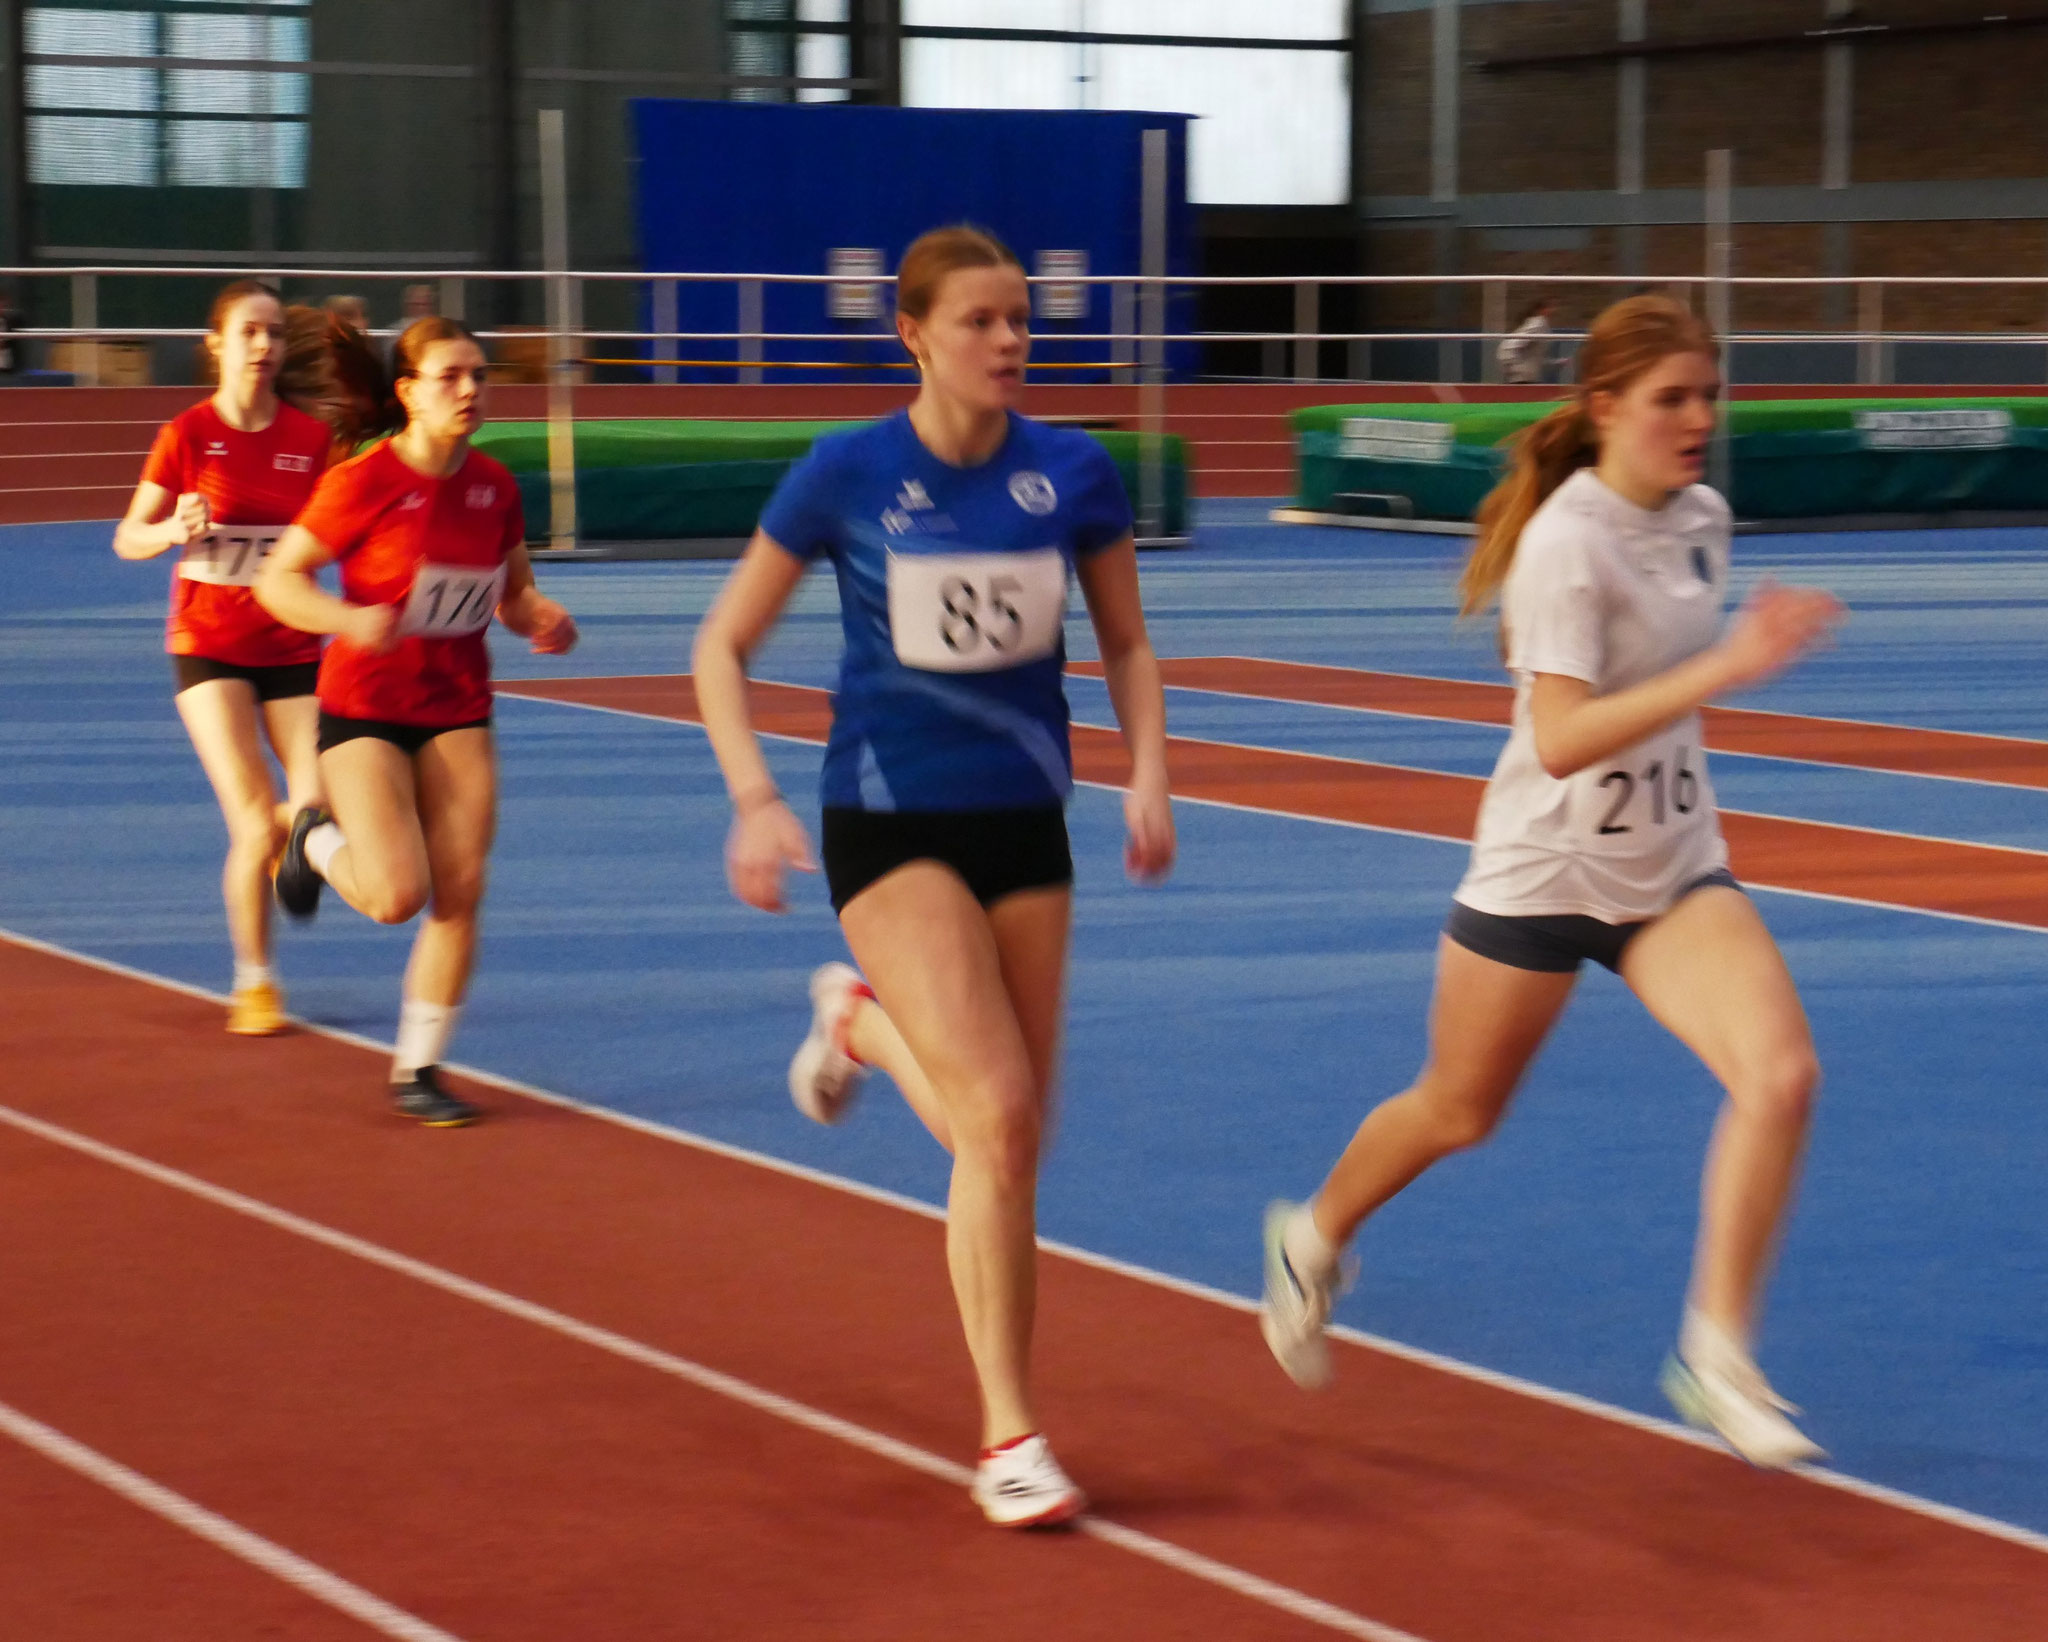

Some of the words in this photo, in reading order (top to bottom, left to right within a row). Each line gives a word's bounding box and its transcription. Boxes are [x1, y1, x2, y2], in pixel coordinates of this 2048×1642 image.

[424, 578, 495, 628] 176
[938, 571, 1025, 654] 85
[1597, 744, 1698, 835] 216
